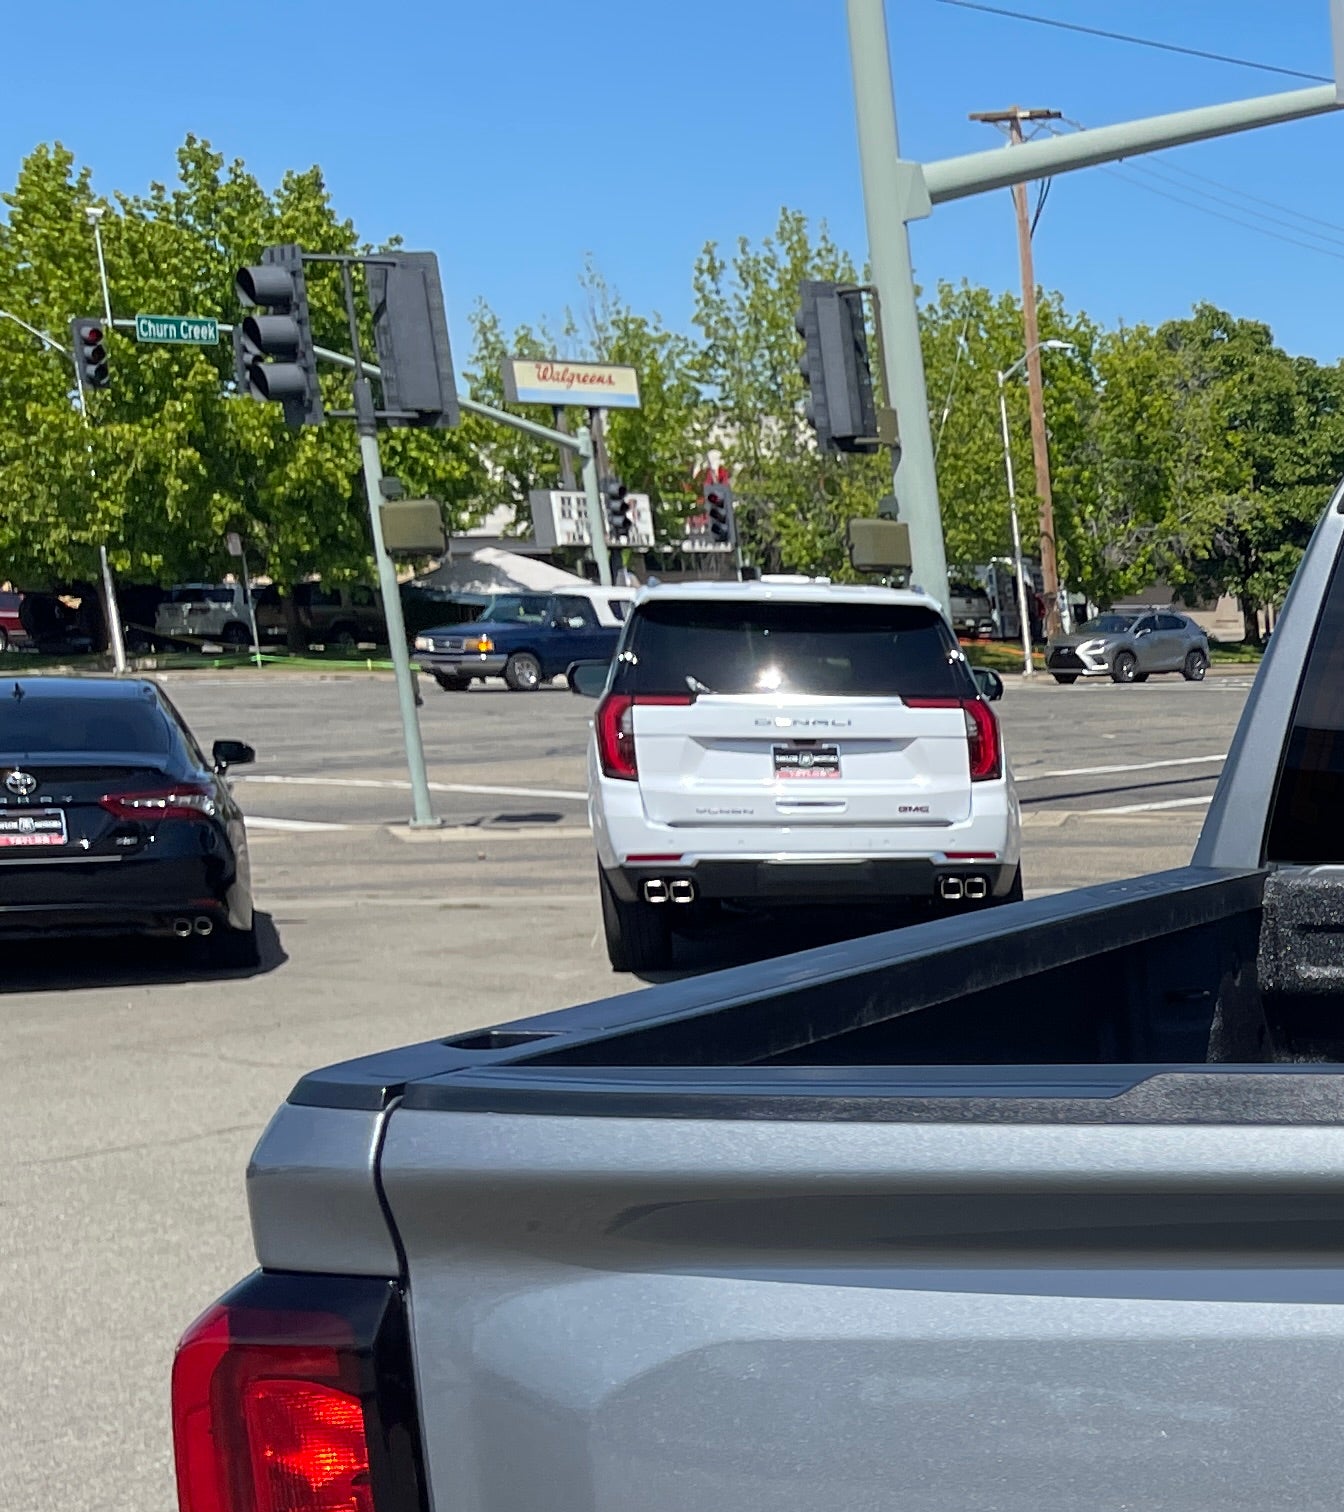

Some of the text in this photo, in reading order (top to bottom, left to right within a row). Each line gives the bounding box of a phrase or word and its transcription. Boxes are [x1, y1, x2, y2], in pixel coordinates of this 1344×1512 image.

[139, 319, 216, 340] Churn Creek
[535, 363, 616, 389] Walgreens
